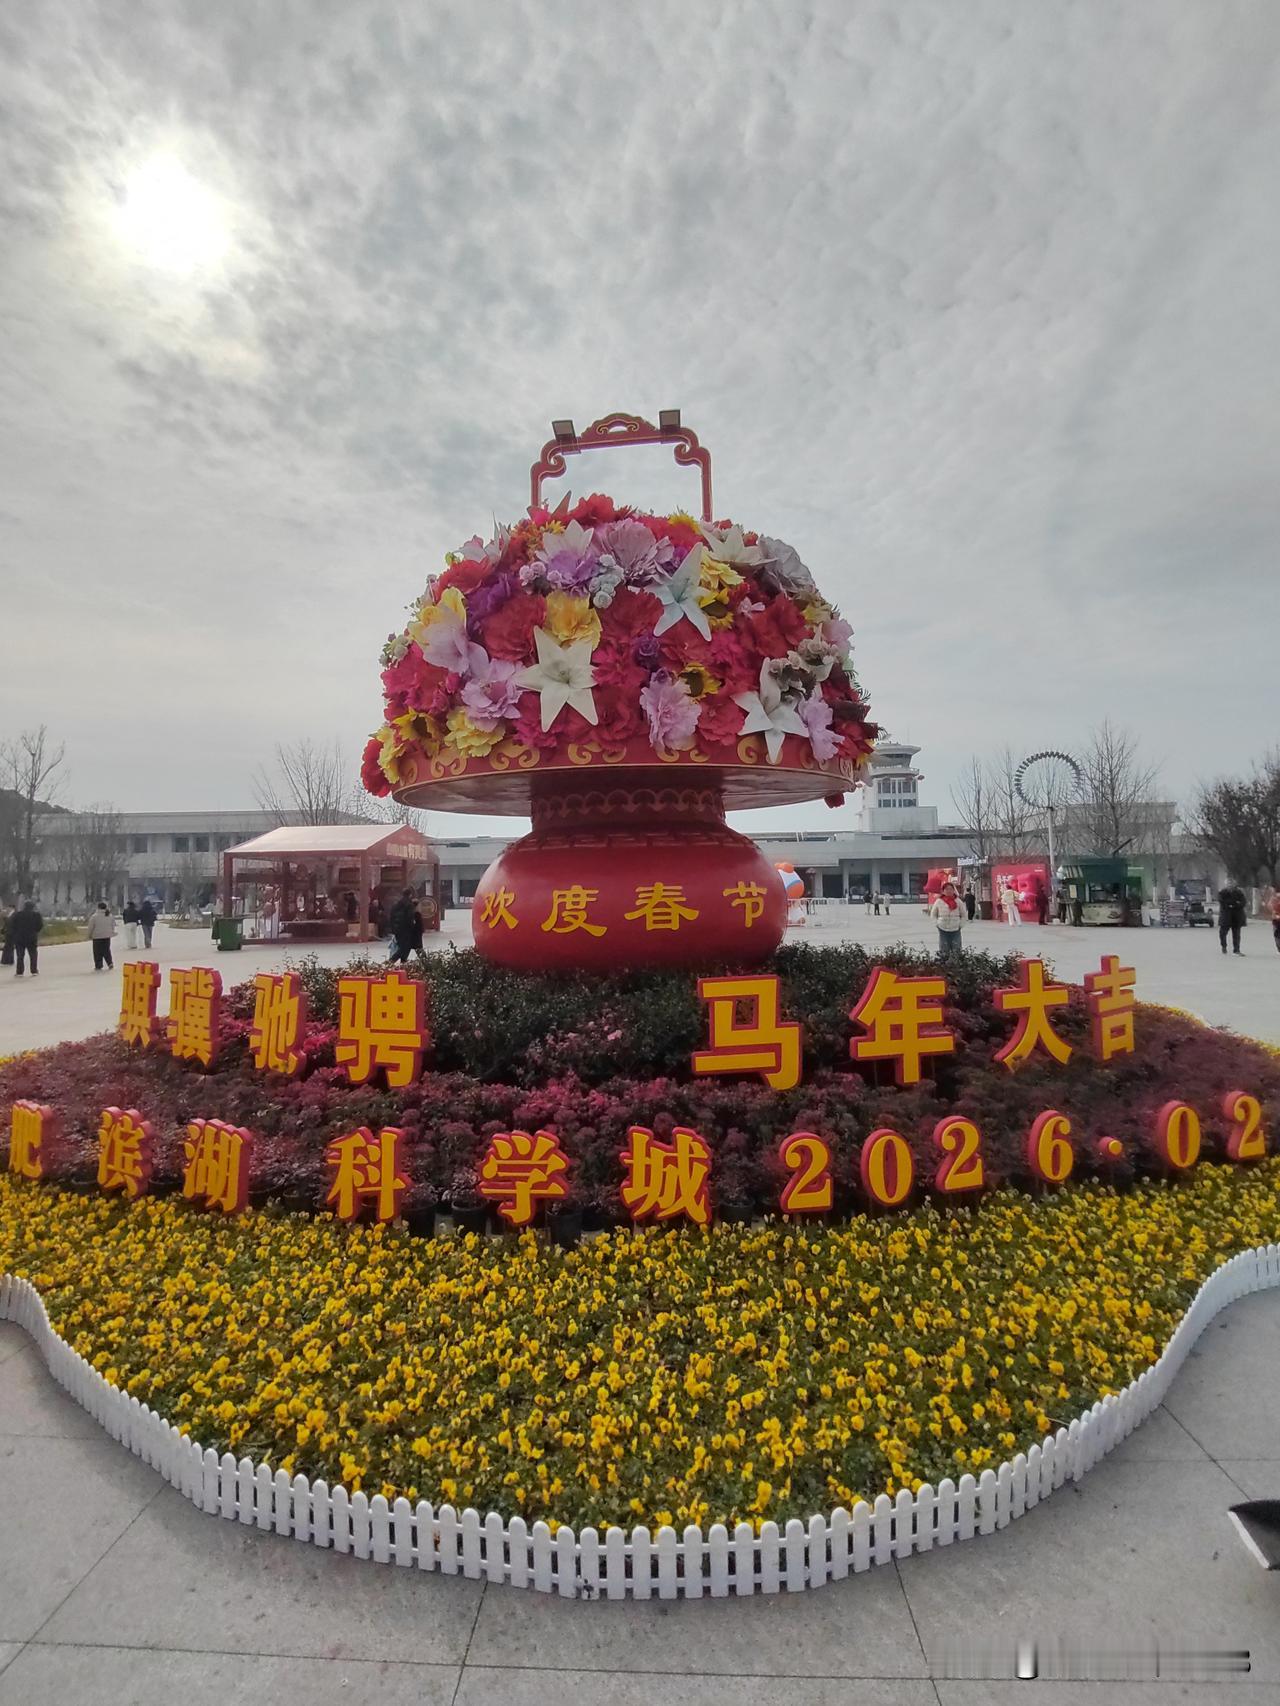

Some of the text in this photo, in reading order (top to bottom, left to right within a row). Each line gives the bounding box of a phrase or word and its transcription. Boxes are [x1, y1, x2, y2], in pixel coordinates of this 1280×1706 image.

[480, 881, 768, 937] 欢度春节
[119, 956, 1136, 1090] 骐骥驰骋 马年大吉
[9, 1102, 711, 1225] 肥滨湖科学城
